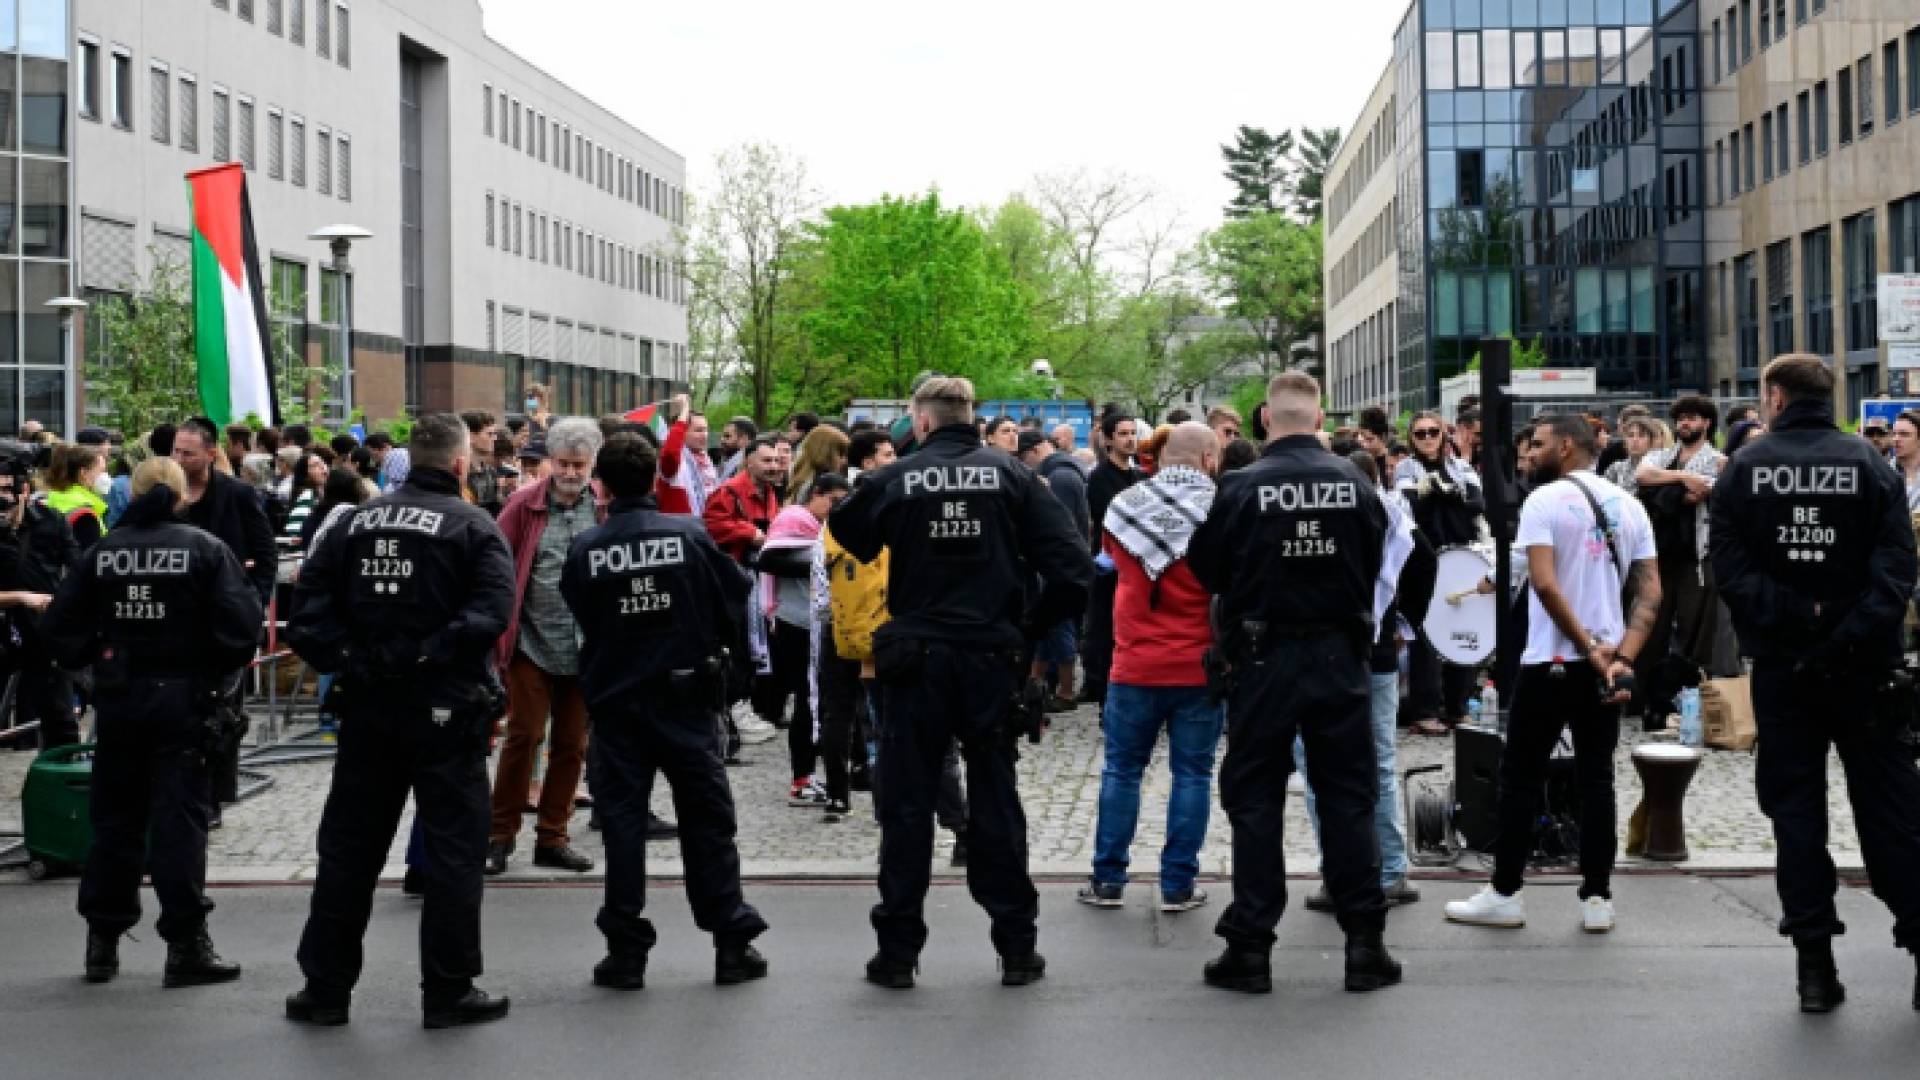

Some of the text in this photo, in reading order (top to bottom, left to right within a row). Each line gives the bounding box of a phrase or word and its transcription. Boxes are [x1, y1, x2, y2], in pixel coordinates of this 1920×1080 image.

[904, 466, 1000, 495] POLIZEI
[1752, 466, 1858, 495] POLIZEI
[1258, 482, 1356, 512] POLIZEI
[942, 502, 968, 519] BE
[1793, 506, 1820, 524] BE
[349, 506, 444, 535] POLIZEI
[929, 520, 981, 538] 21223
[1296, 521, 1321, 538] BE
[1777, 526, 1836, 544] 21200
[375, 539, 401, 557] BE
[589, 536, 684, 577] POLIZEI
[1282, 538, 1337, 557] 21216
[97, 550, 190, 576] POLIZEI
[361, 558, 413, 577] 21220
[128, 586, 152, 601] BE
[631, 575, 656, 594] BE
